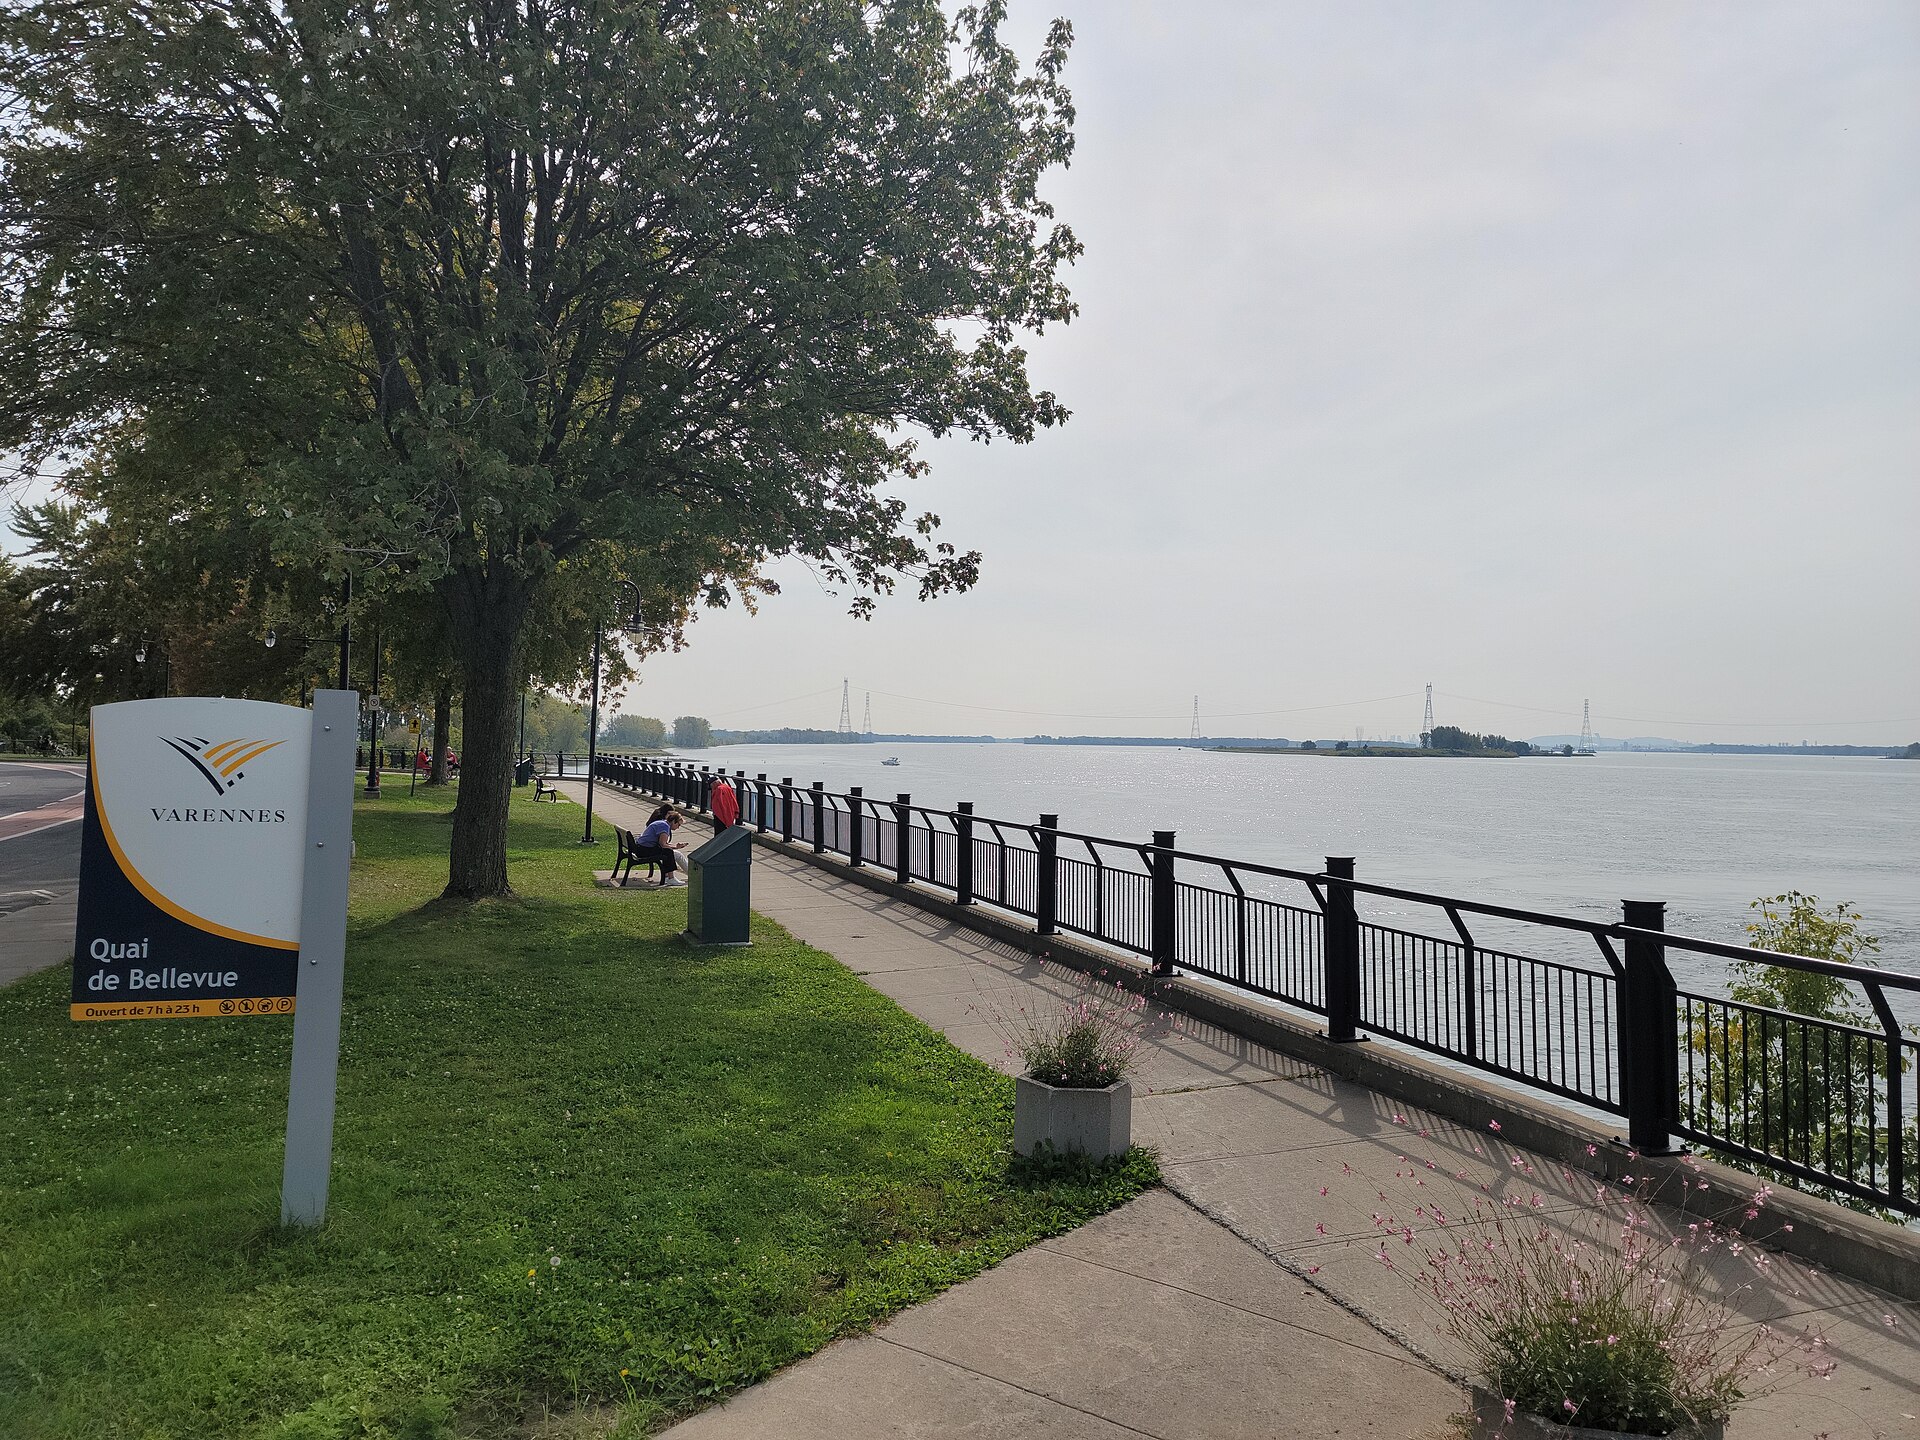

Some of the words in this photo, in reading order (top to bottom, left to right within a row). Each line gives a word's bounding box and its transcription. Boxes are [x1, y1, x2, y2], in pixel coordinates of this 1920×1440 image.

[150, 808, 286, 823] VARENNES
[90, 937, 149, 963] Quai
[87, 969, 120, 991] de
[129, 967, 239, 990] Bellevue
[85, 1007, 127, 1017] Ouvert
[129, 1006, 144, 1016] de
[146, 1005, 154, 1015] 7
[155, 1005, 164, 1015] h
[165, 1004, 173, 1014] à
[174, 1004, 190, 1014] 23
[192, 1004, 200, 1013] h
